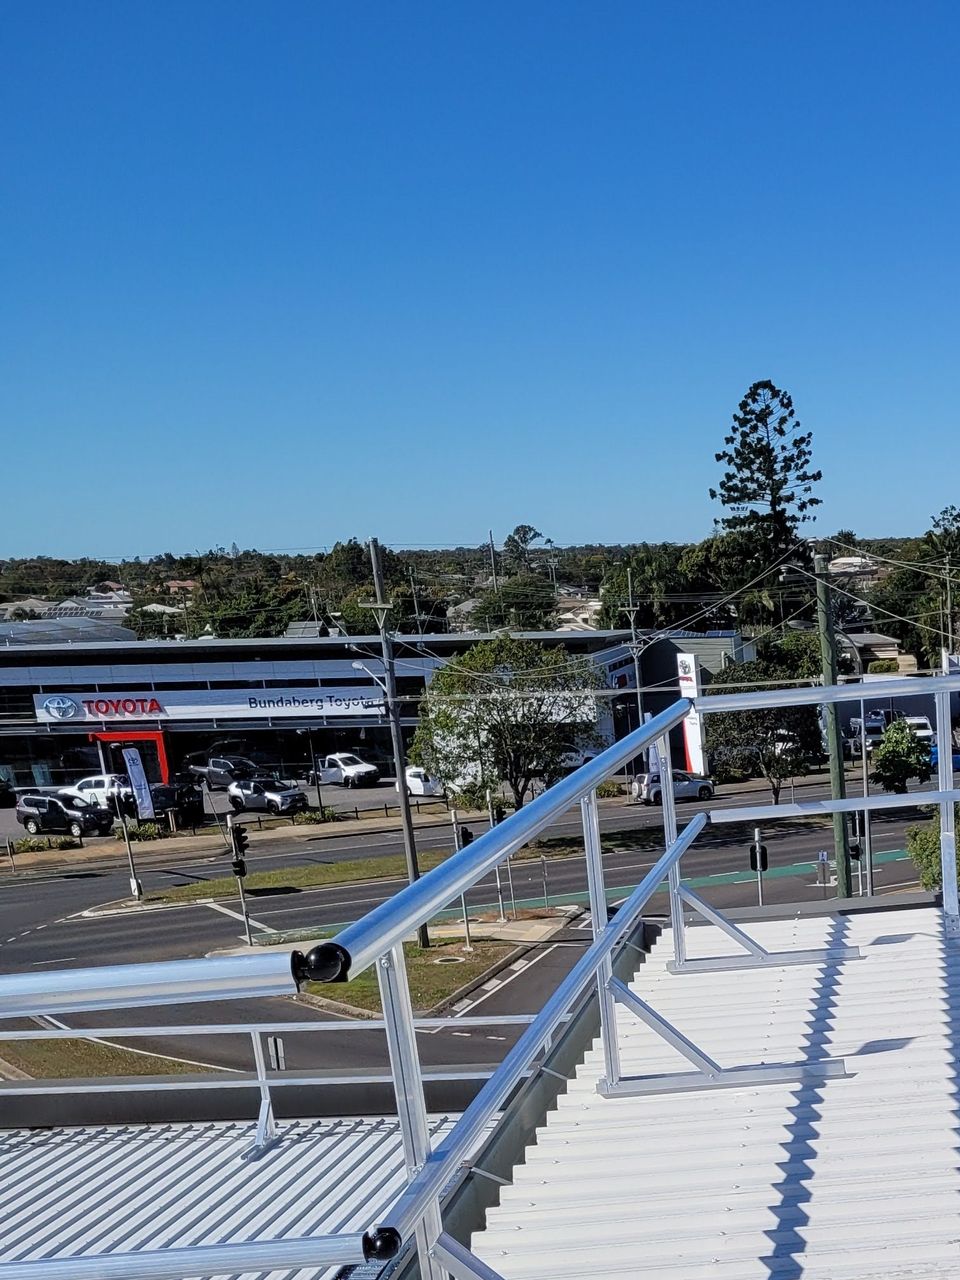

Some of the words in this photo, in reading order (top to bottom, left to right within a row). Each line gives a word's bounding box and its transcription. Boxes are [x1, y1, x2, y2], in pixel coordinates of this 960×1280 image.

[82, 698, 162, 715] TOYOTA
[248, 696, 324, 710] Bundaberg
[326, 695, 374, 710] Toyota
